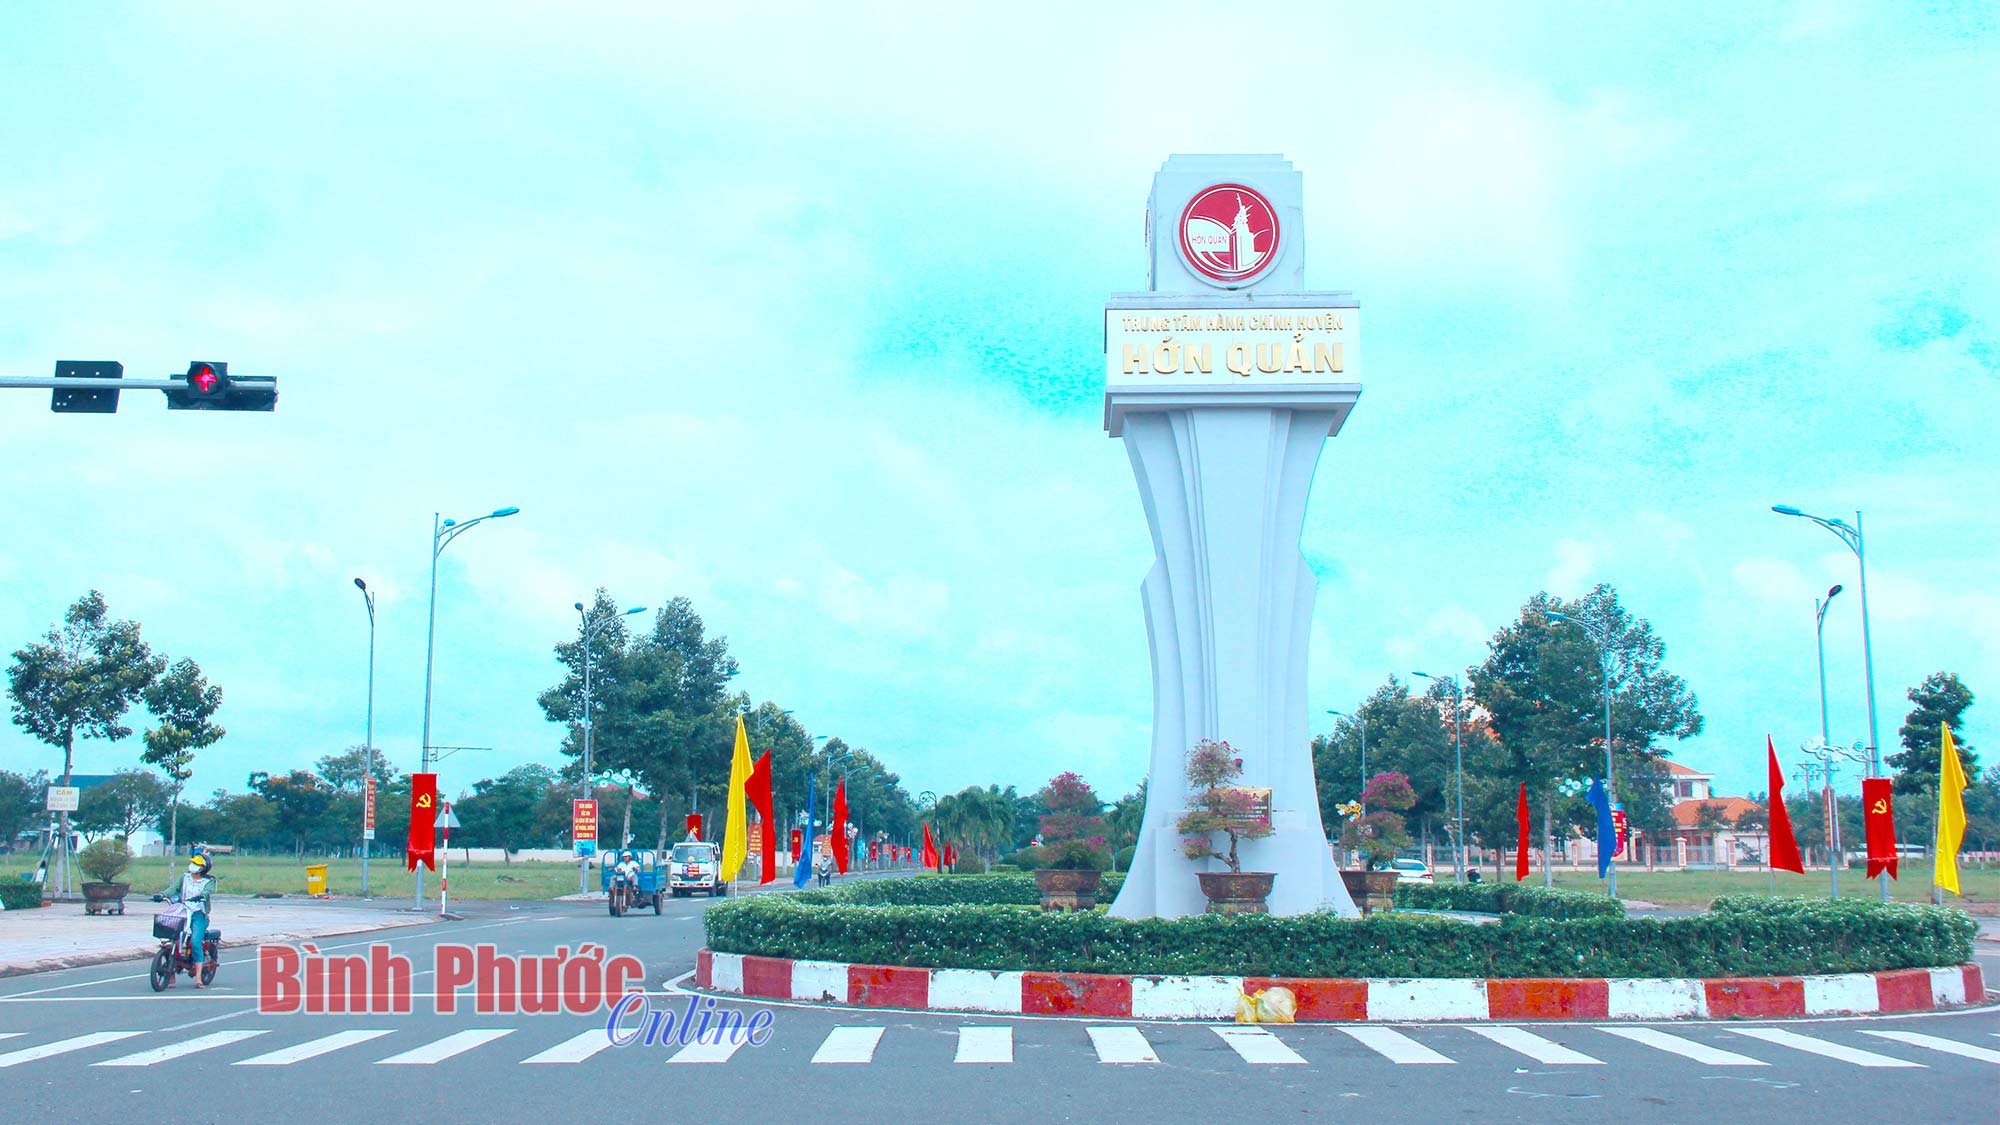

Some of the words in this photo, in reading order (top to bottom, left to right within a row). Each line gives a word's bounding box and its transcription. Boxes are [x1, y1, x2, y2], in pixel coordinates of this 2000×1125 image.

[1122, 316, 1170, 332] TRUNG
[1173, 314, 1203, 332] TÂM
[1207, 313, 1245, 331] HÀNH
[1249, 314, 1293, 331] CHÍNH
[1297, 313, 1343, 333] HUYỆN
[1122, 335, 1213, 374] HỚN
[1226, 333, 1344, 376] QUẢN
